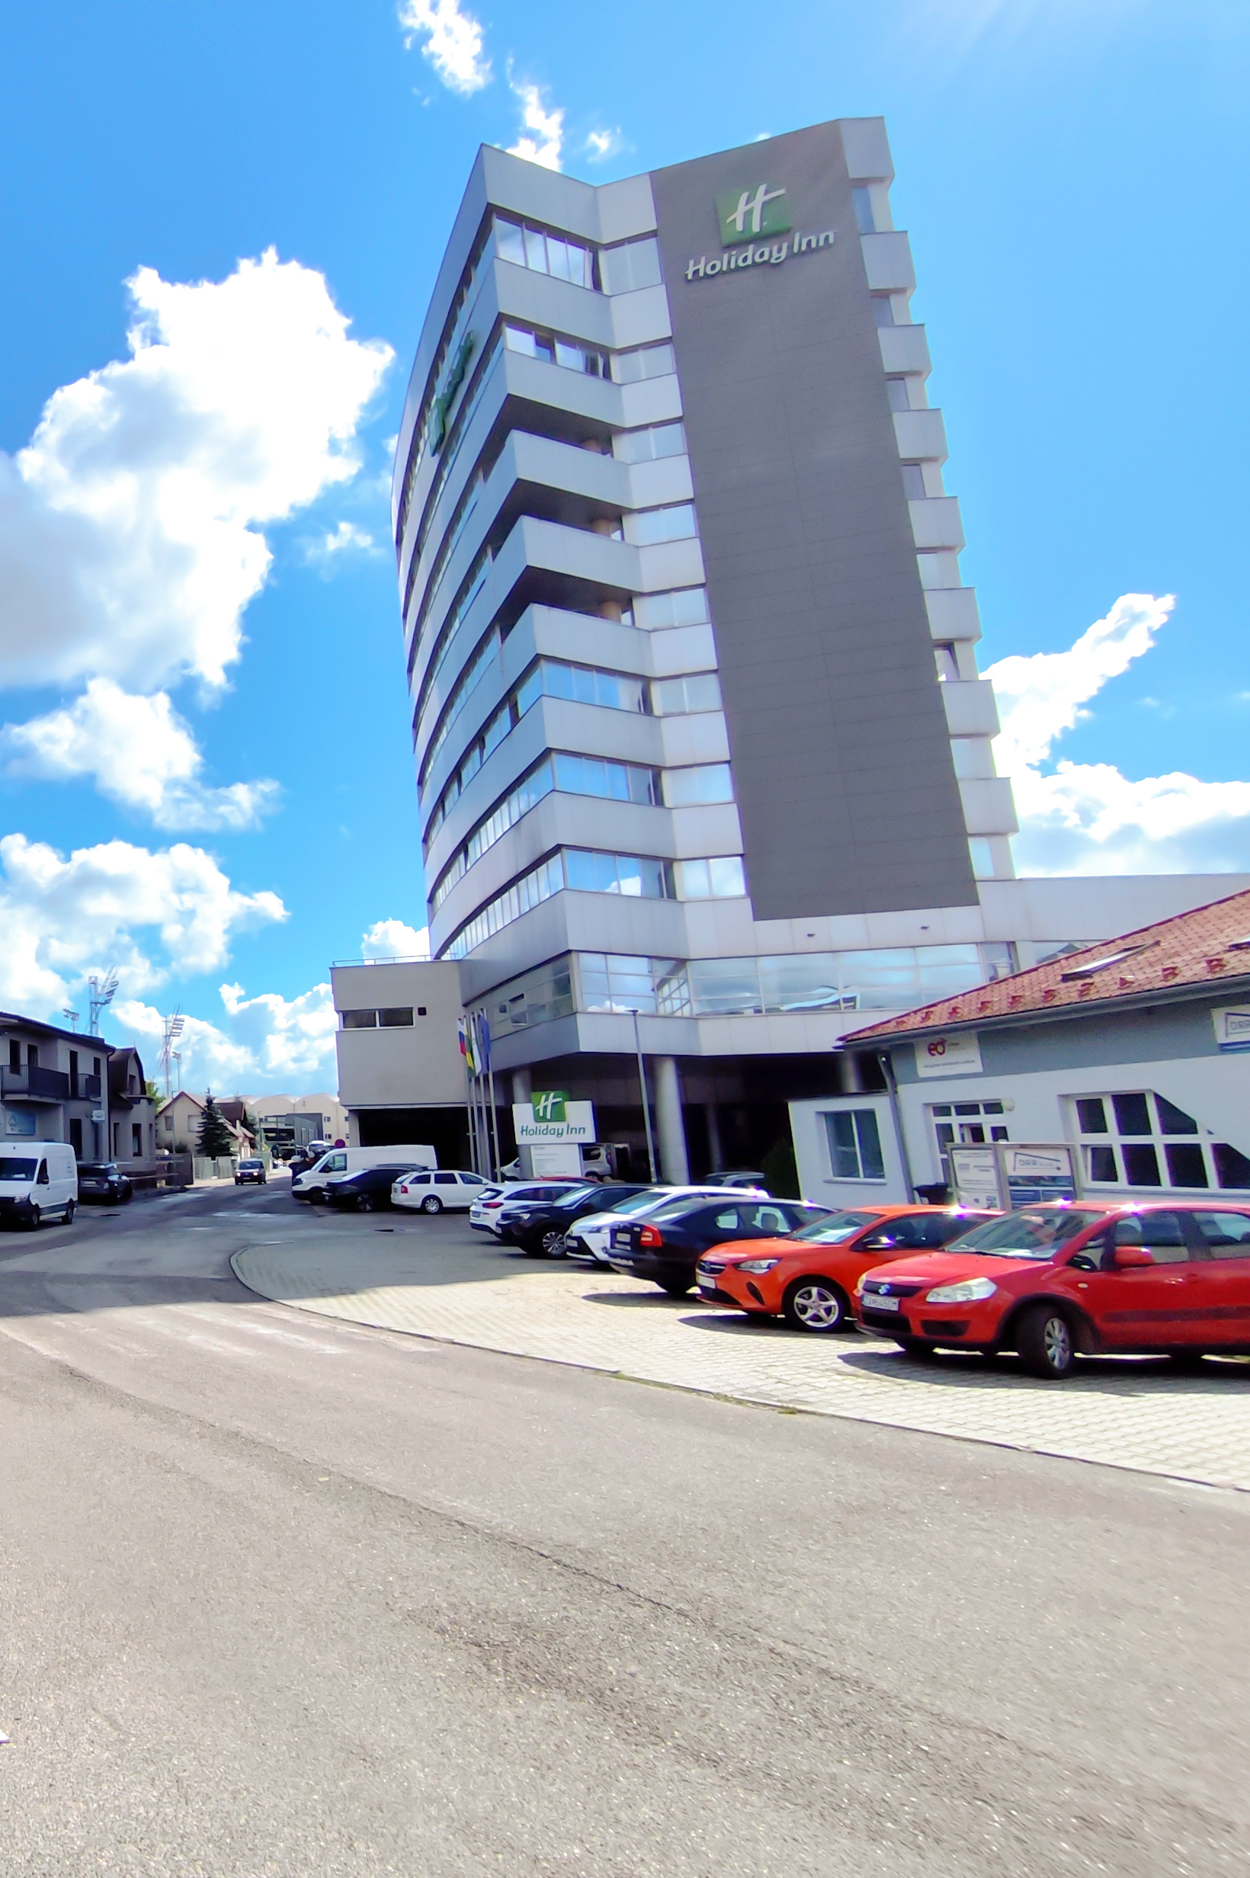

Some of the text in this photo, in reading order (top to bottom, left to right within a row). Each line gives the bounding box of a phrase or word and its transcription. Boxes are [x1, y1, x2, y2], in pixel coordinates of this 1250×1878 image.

[685, 230, 835, 280] Holiday Inn
[520, 1123, 586, 1139] Holiday Inn
